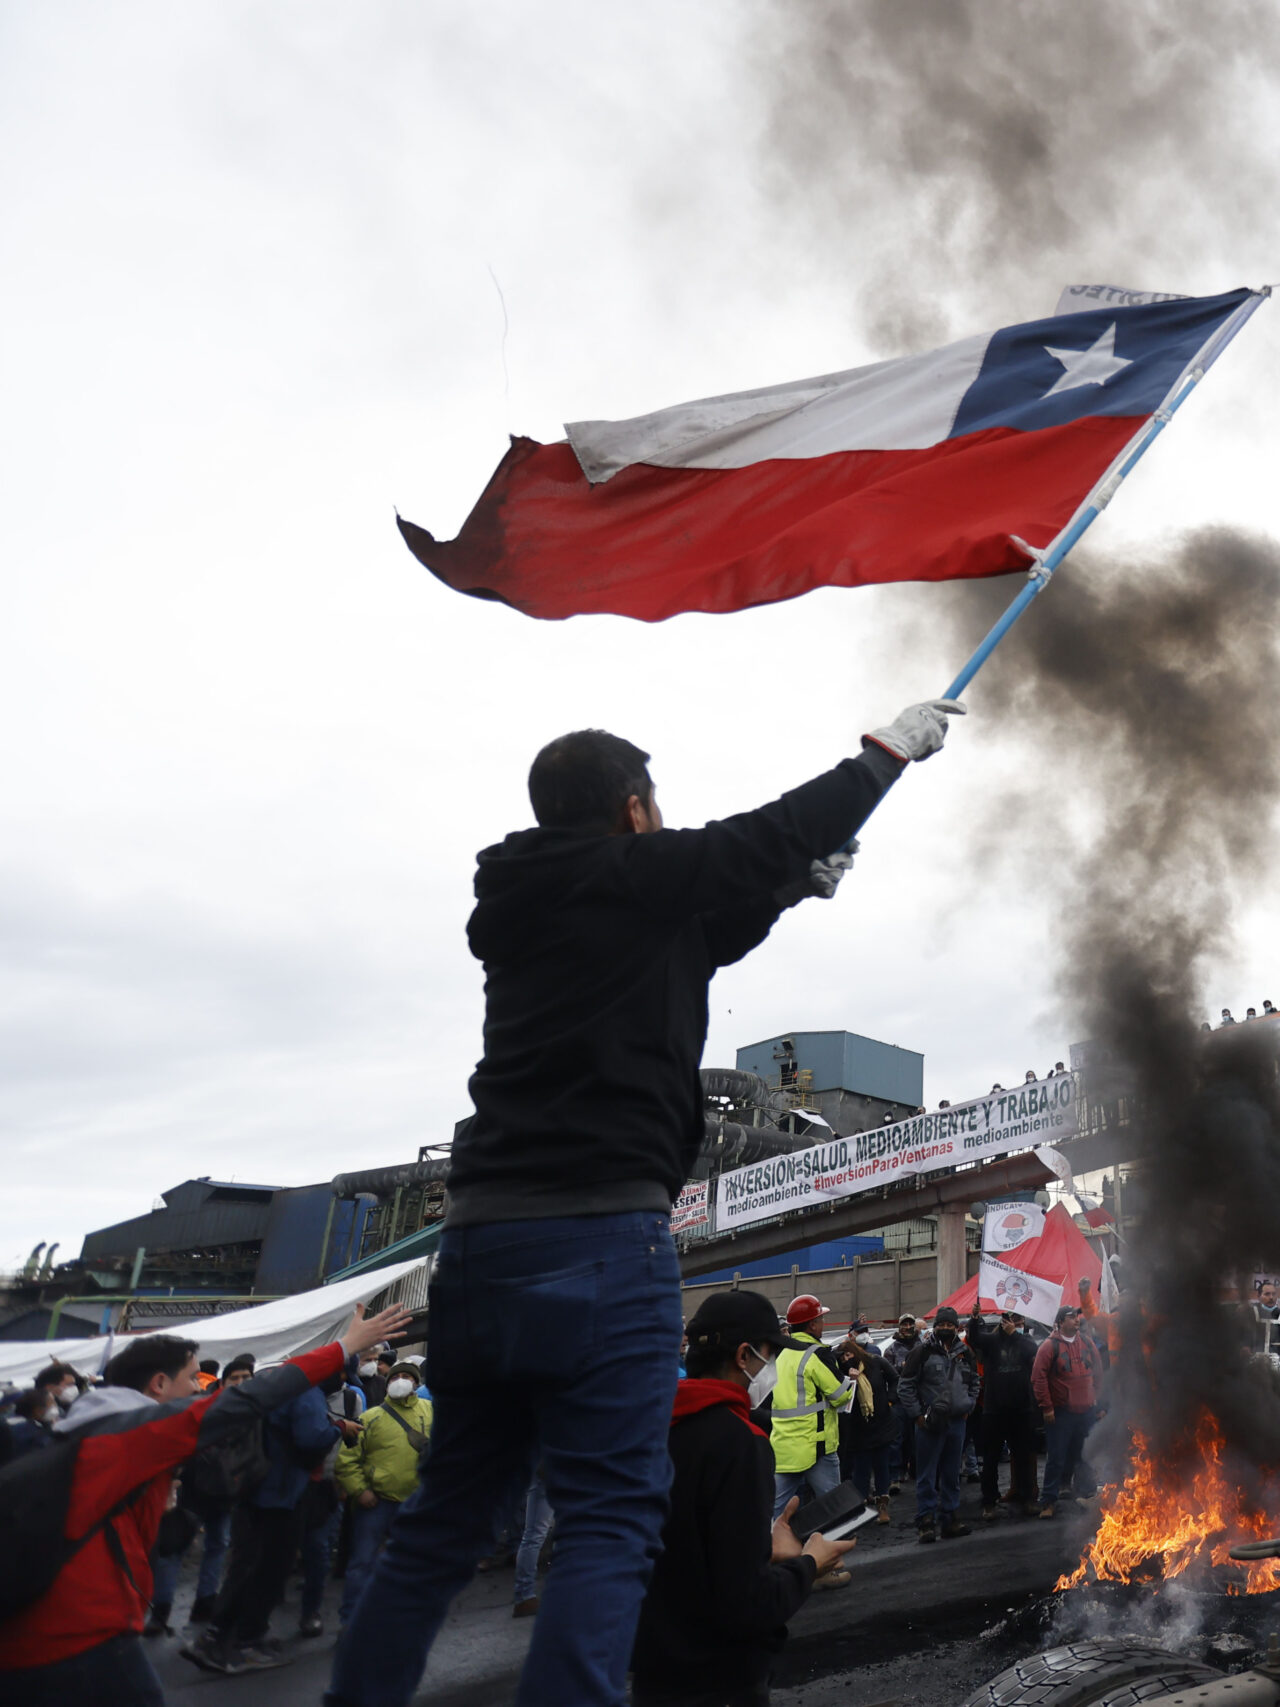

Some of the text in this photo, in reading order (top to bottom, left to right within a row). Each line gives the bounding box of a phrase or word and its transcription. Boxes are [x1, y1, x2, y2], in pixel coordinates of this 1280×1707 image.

[727, 1183, 811, 1217] medioambiente
[963, 1112, 1064, 1150] medioambiente
[856, 1105, 977, 1163] MEDIOAMBIENTE
[982, 1100, 993, 1128] Y
[997, 1079, 1071, 1124] TRABAJO
